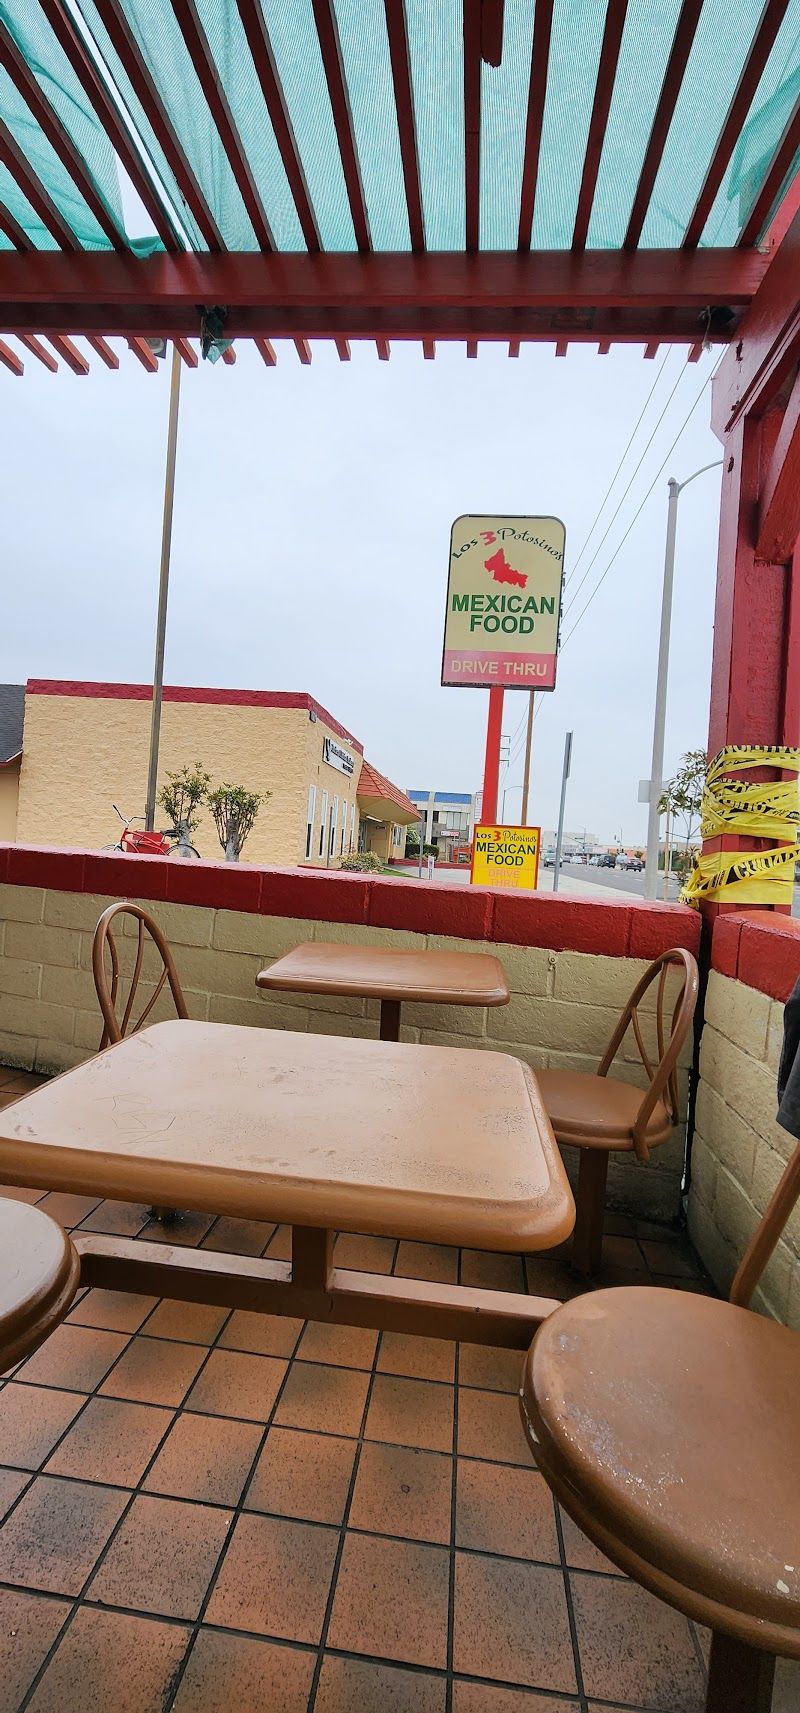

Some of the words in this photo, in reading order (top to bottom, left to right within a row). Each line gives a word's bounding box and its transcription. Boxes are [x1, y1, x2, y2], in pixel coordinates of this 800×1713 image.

[480, 530, 497, 546] 3
[452, 594, 556, 614] MEXICAN
[470, 615, 535, 634] FOOD
[451, 660, 499, 674] DRIVE
[503, 662, 547, 676] THRU
[493, 830, 502, 842] 3
[476, 841, 536, 855] MEXICAN
[486, 854, 524, 866] FOOD
[489, 868, 520, 879] DRIVE
[490, 879, 518, 888] THRU
